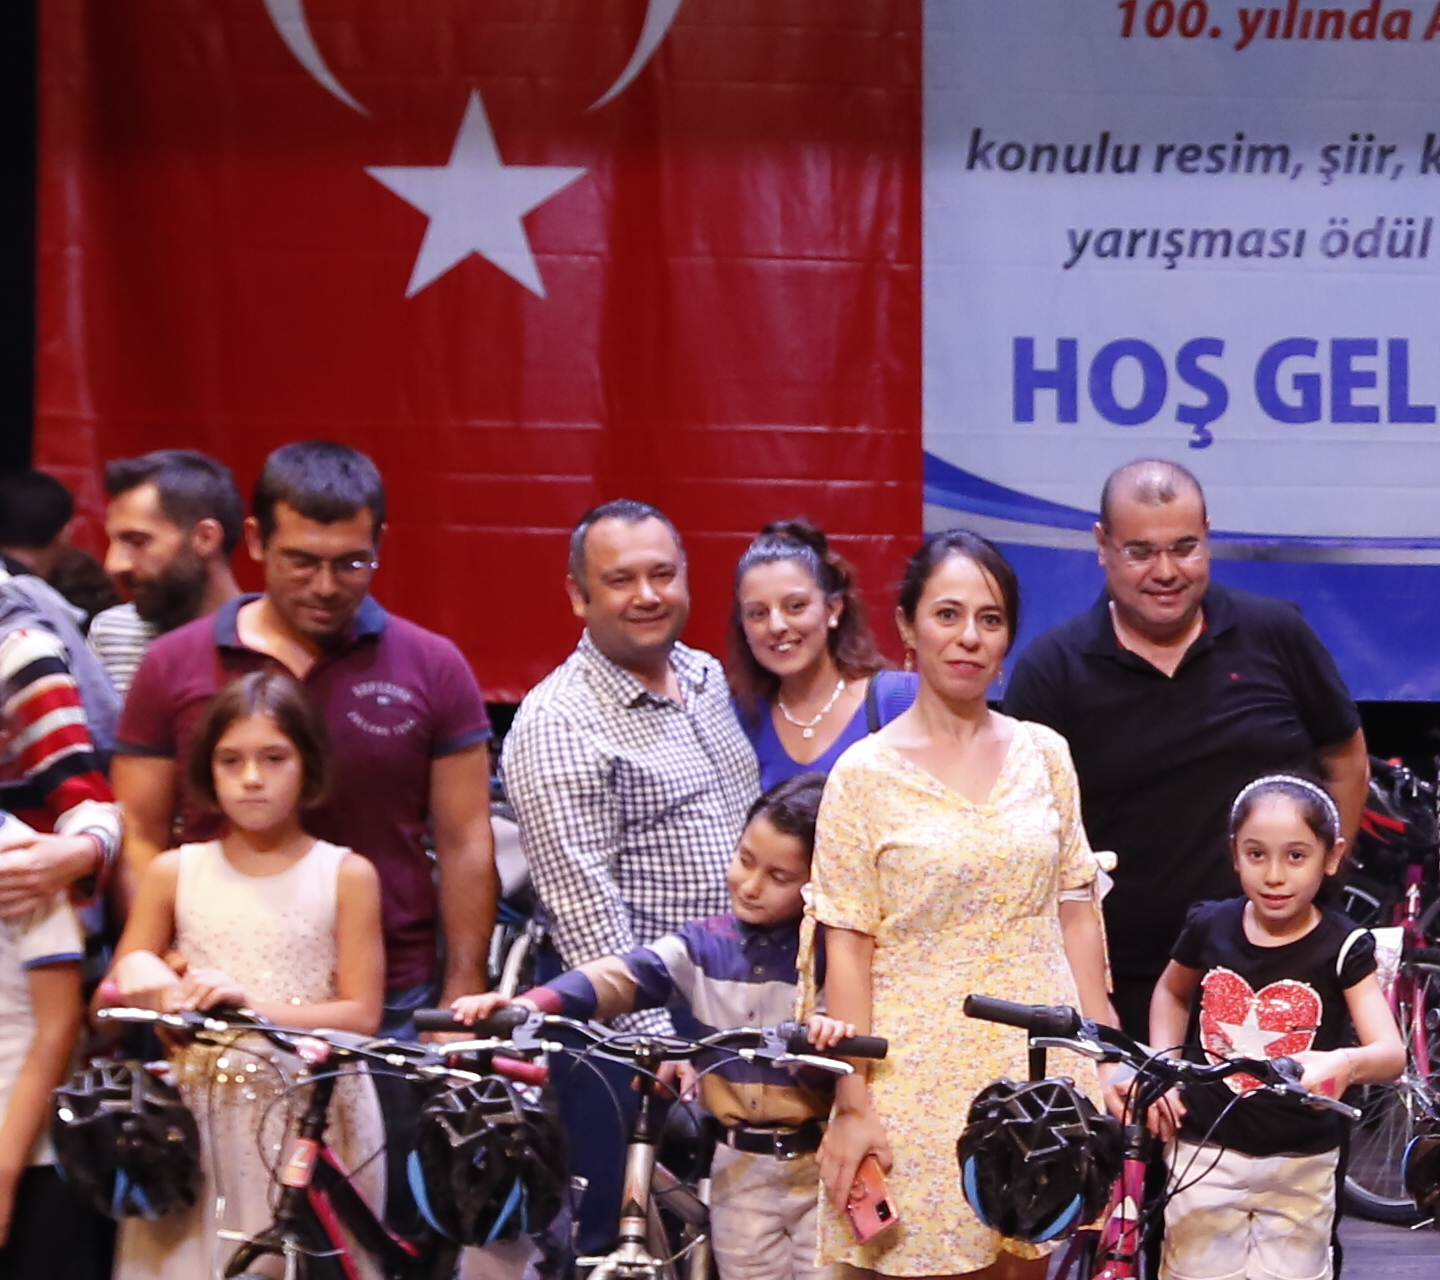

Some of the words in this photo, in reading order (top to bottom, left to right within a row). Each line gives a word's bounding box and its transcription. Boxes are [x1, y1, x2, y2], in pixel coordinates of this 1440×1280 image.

[965, 127, 1141, 175] konulu
[1153, 131, 1303, 180] resim,
[1318, 132, 1404, 186] şiir,
[1062, 228, 1307, 271] yarışması
[1320, 216, 1434, 260] ödül
[1012, 336, 1230, 451] HOŞ
